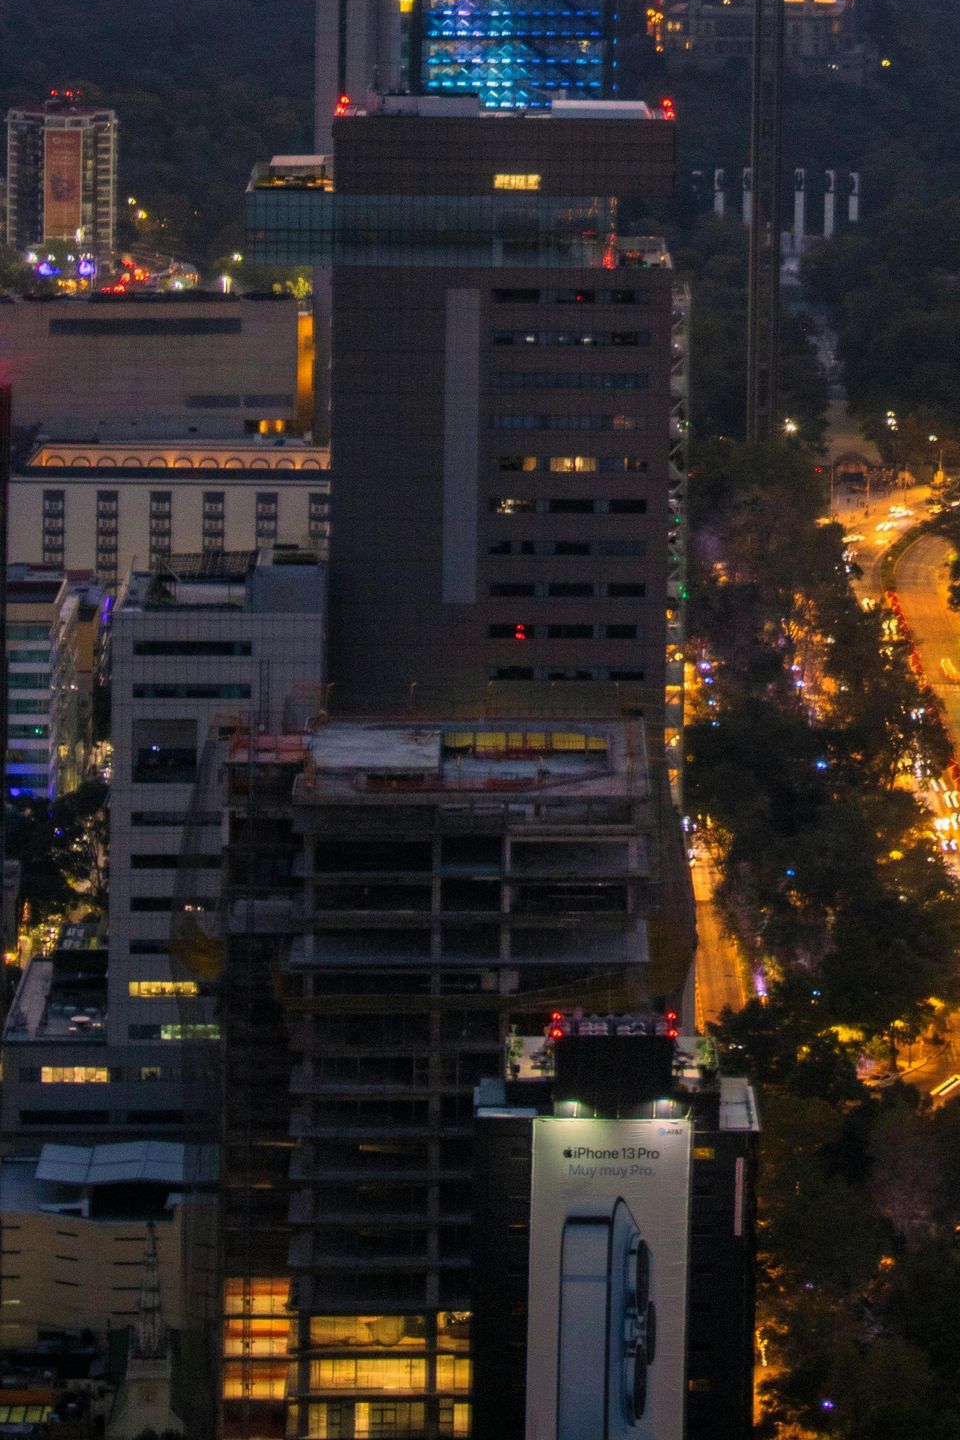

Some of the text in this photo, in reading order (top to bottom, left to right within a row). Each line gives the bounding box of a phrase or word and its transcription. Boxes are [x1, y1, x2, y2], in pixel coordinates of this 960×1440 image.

[574, 1147, 660, 1159] iPhone 13 Pro
[568, 1164, 597, 1178] Muy
[600, 1166, 627, 1178] muy
